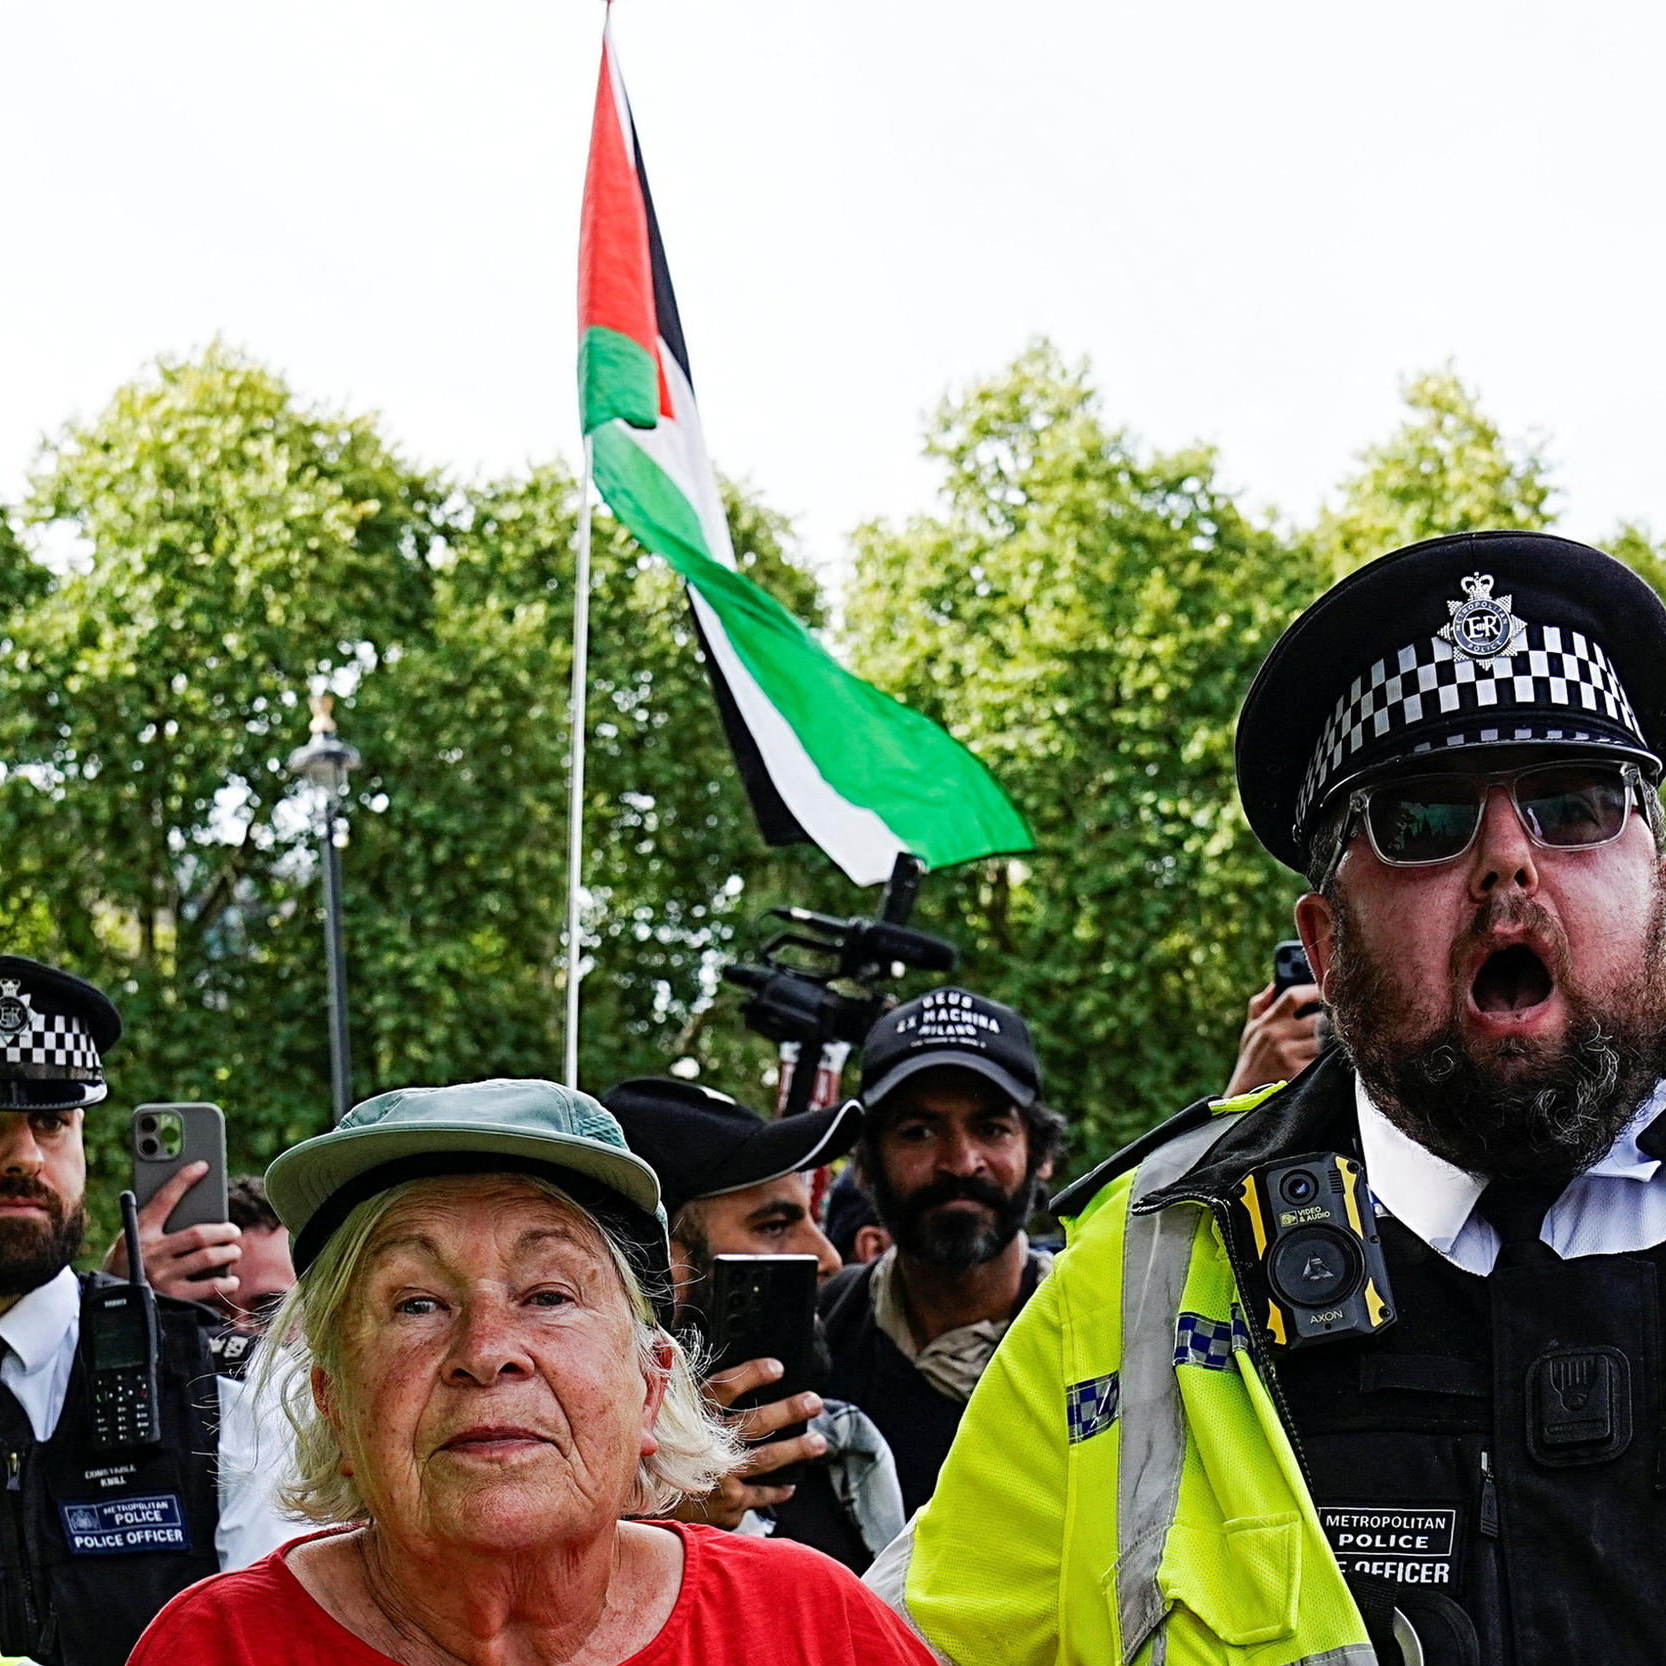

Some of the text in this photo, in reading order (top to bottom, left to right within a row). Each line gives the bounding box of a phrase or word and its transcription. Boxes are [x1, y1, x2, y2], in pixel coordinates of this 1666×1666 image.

[1467, 640, 1503, 653] POLICE
[922, 1008, 1001, 1035] MACHINA
[918, 1024, 977, 1036] MILANO
[1297, 1206, 1322, 1217] VIDEO
[1306, 1210, 1331, 1222] AUDIO
[1310, 1309, 1343, 1324] AXON
[103, 1501, 169, 1515] METROPOLITAN
[114, 1511, 163, 1526] POLICE
[1326, 1515, 1446, 1530] METROPOLITAN
[74, 1529, 183, 1548] POLICE OFFICER
[1338, 1533, 1429, 1549] POLICE
